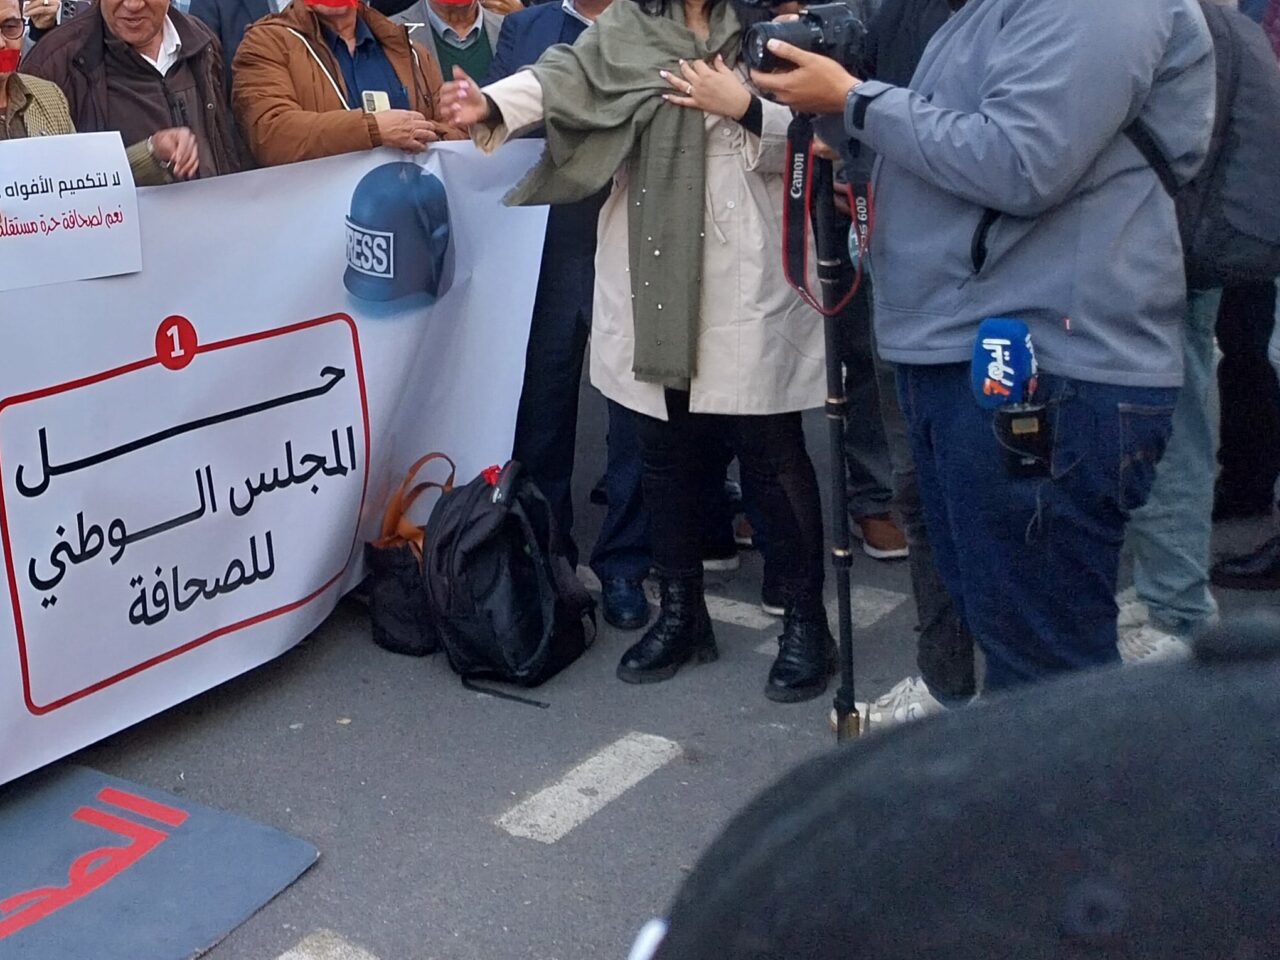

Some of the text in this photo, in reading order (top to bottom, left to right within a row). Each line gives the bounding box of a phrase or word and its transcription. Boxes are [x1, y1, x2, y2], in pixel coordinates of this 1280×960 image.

[5, 175, 54, 201] الأفواه
[58, 172, 108, 198] لتكميم
[112, 171, 121, 185] لا
[790, 153, 804, 198] Canon
[62, 206, 102, 230] لصحافة
[105, 204, 124, 228] نعم
[856, 196, 868, 221] 60D
[39, 214, 60, 236] حرة
[165, 324, 184, 358] 1
[14, 363, 346, 498] حل
[26, 426, 357, 607] المجلس الوطني
[127, 531, 276, 626] للصحافة
